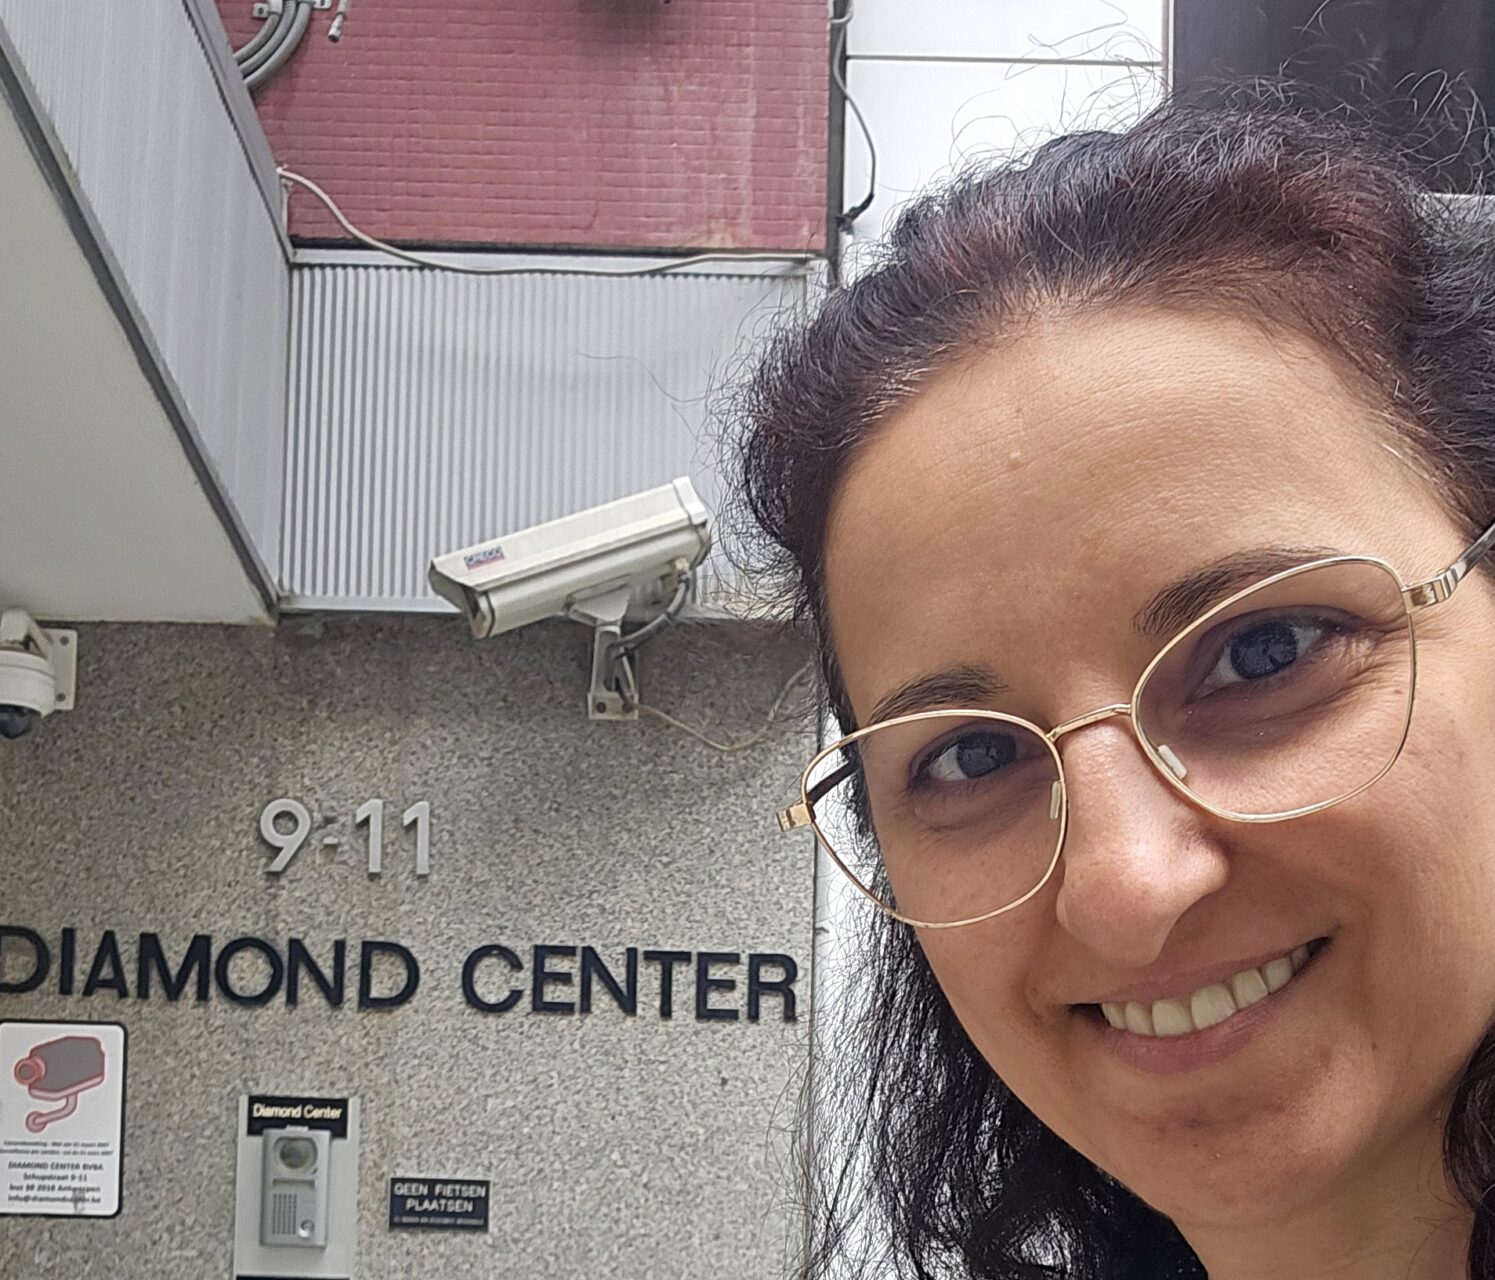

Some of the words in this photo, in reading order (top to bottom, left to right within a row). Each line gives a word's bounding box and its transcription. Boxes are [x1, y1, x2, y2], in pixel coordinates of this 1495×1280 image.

[260, 798, 430, 875] 9-11
[0, 924, 420, 1009] DIAMOND
[461, 944, 798, 1022] CENTER
[252, 1102, 302, 1118] Diamond
[303, 1104, 342, 1119] Center
[8, 1161, 49, 1170] DIAMOND
[50, 1162, 80, 1170] CENTER
[394, 1182, 429, 1196] GEEN
[434, 1183, 486, 1198] FIETSEN
[405, 1198, 474, 1213] PLAATSEN
